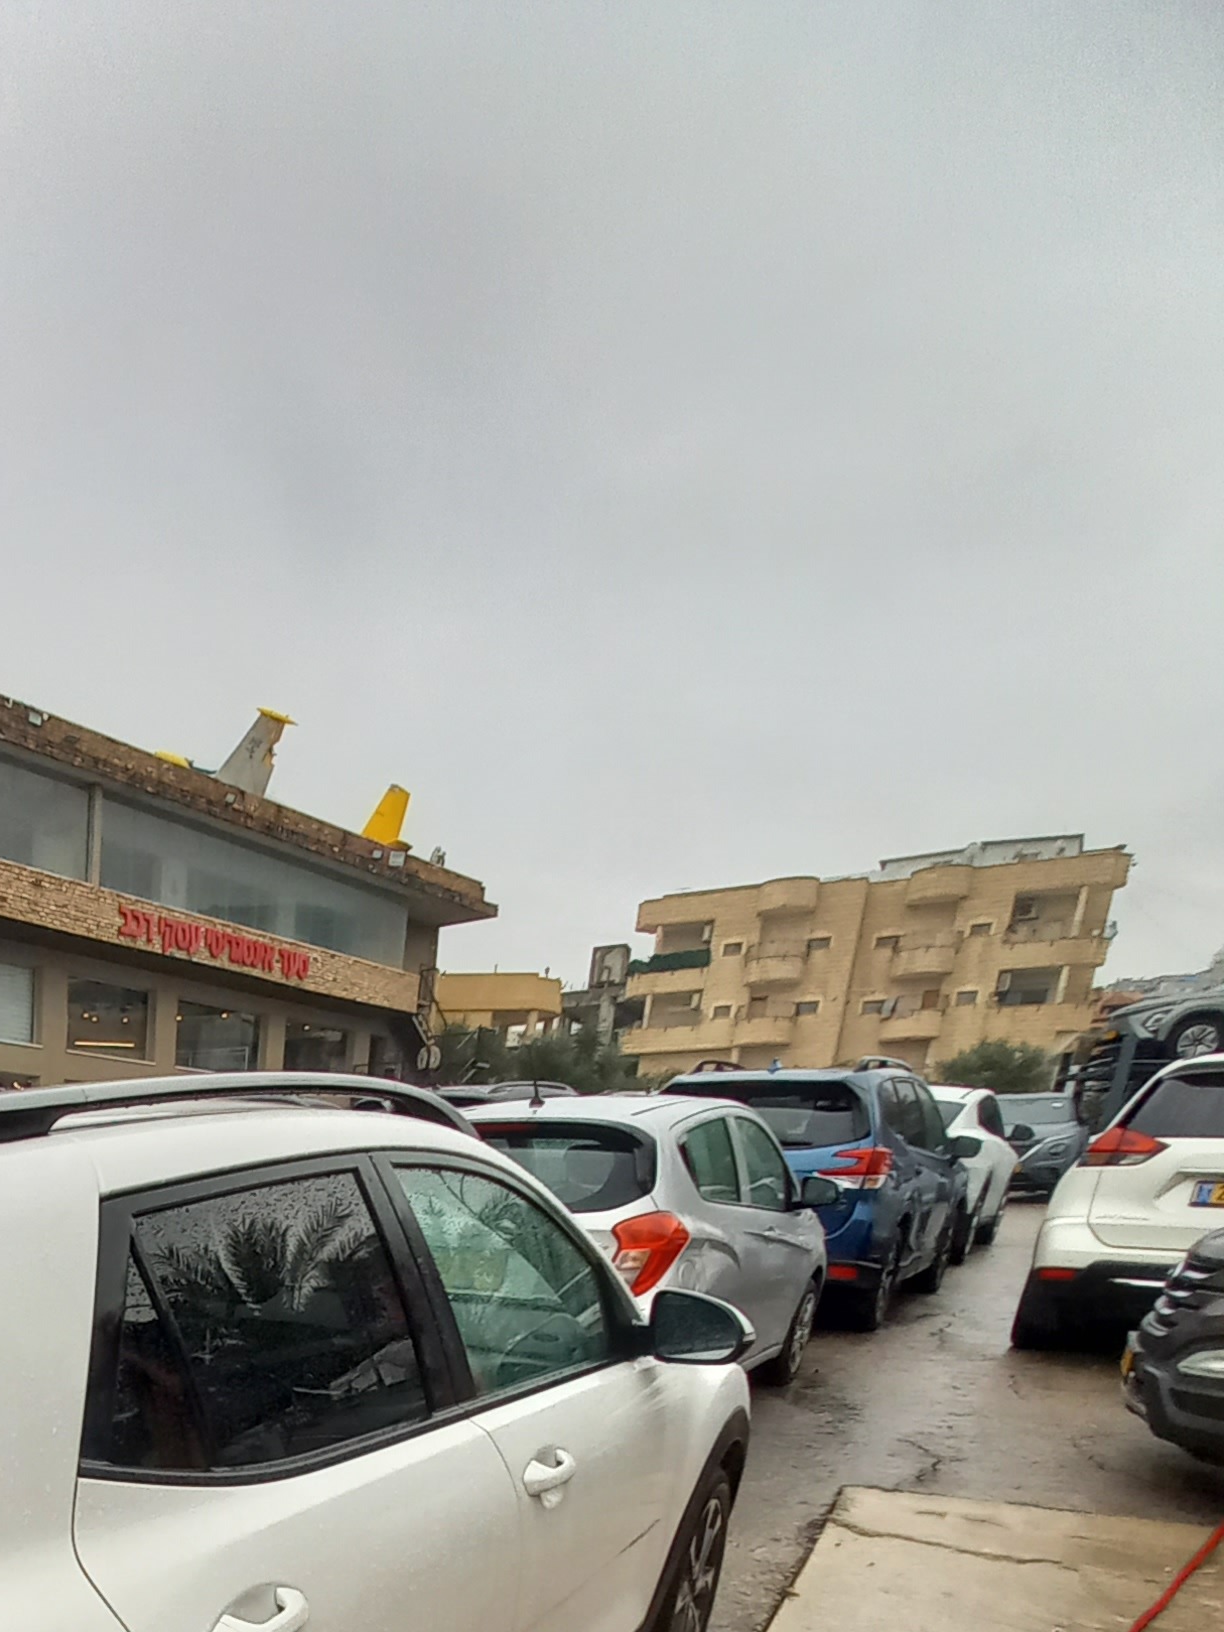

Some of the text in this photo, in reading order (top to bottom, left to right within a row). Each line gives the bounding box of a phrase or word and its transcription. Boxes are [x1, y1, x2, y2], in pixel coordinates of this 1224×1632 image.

[119, 903, 311, 980] סעד אינטגריטי עסקי רכב
